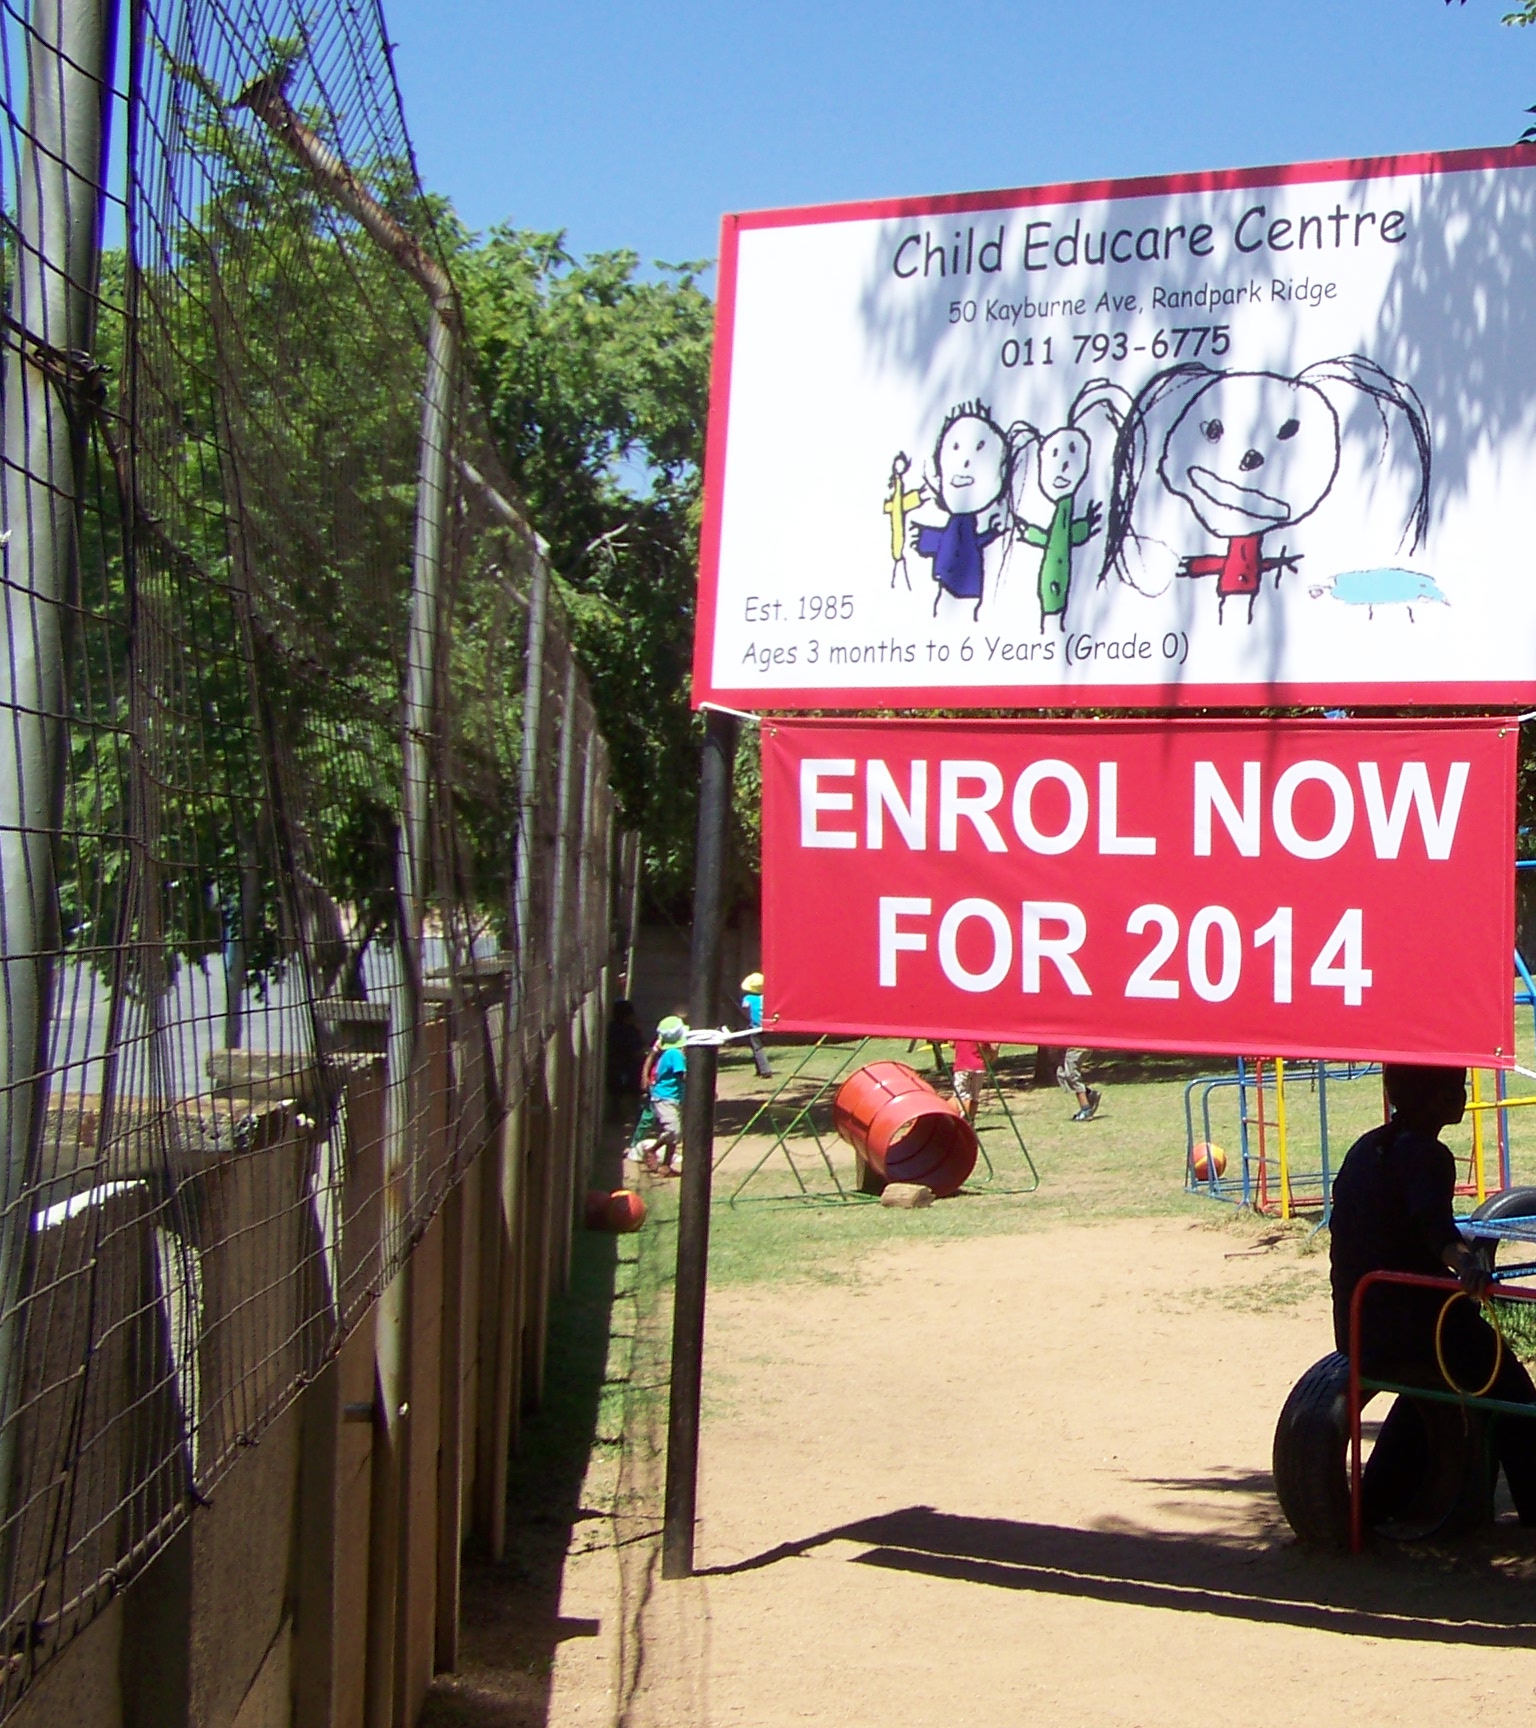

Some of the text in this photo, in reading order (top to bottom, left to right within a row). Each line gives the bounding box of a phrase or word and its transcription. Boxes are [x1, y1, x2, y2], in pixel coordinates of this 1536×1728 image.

[893, 204, 1408, 279] Child Educare Centre
[949, 277, 1338, 327] 50 Kayburne Ave, Randpark Ridge
[1001, 325, 1231, 368] 011 793-6775
[745, 595, 854, 622] Est. 1985
[742, 631, 1189, 672] Ages 3 months to 6 Years (Grade 0)
[799, 758, 1471, 861] ENROL NOW
[879, 896, 1373, 1006] FOR 2014
